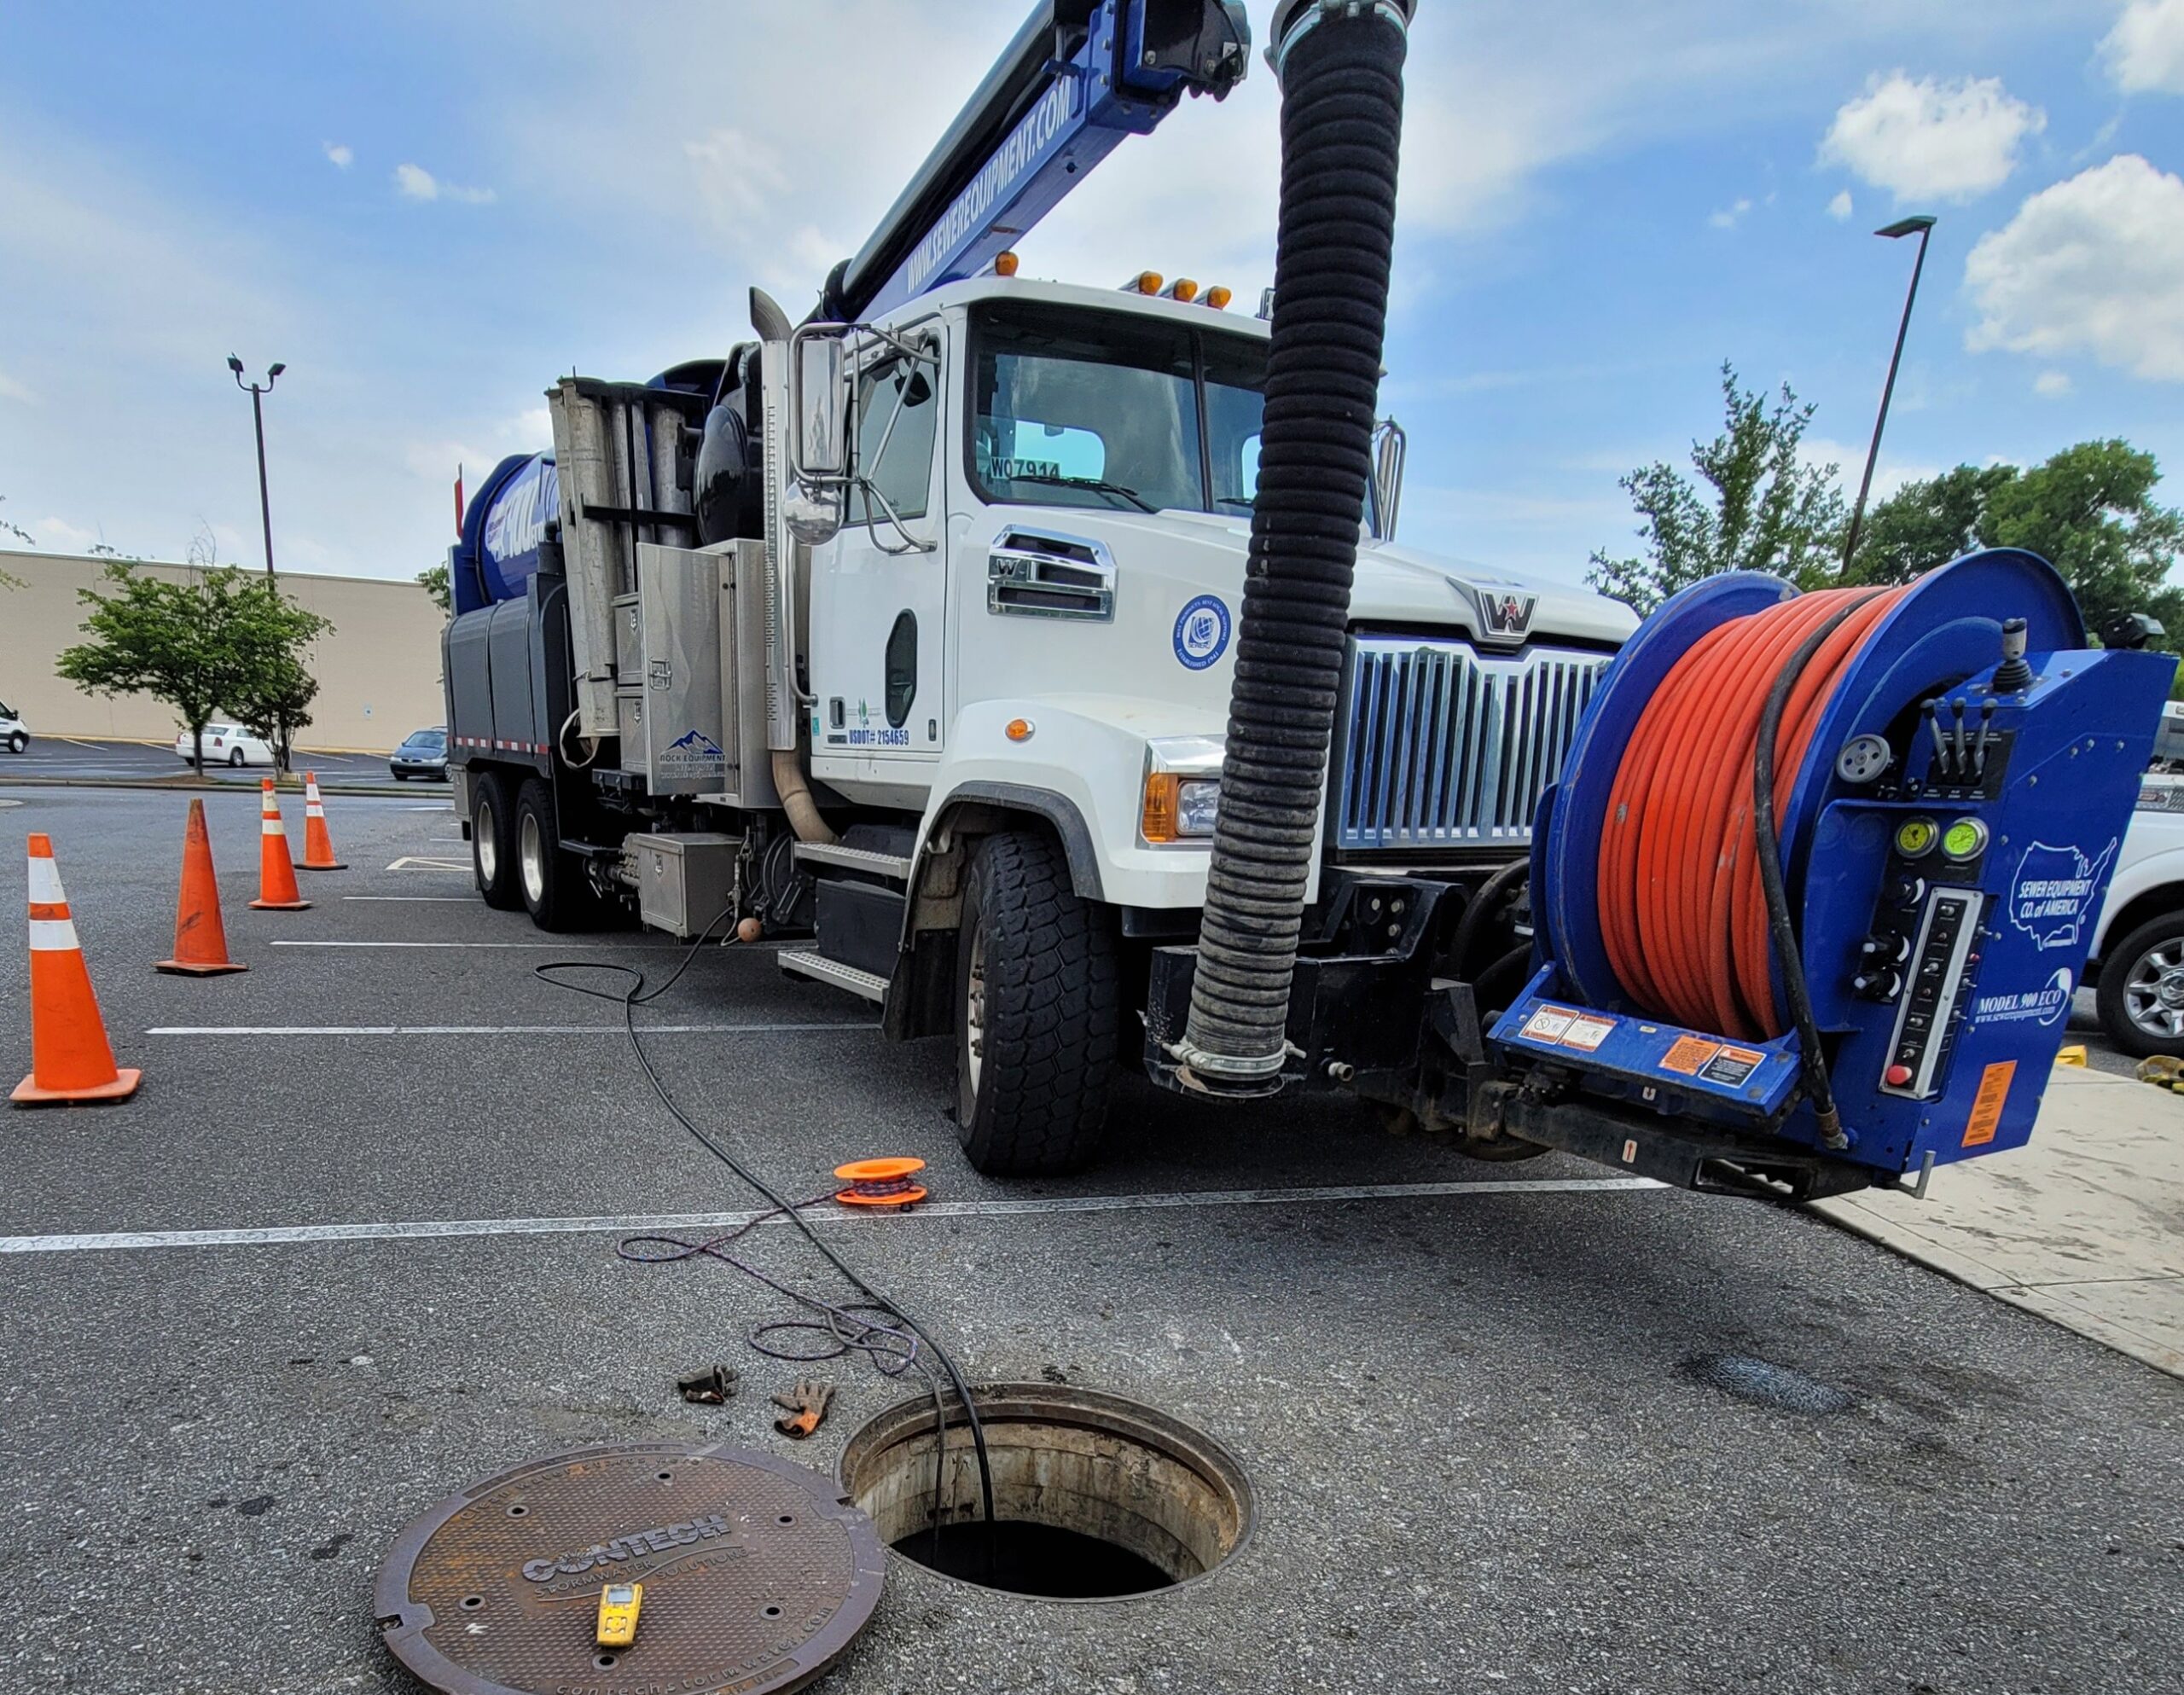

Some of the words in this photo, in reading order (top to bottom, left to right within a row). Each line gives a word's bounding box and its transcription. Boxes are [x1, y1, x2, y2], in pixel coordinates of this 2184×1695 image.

[907, 74, 1072, 294] WWW.SEWEREQUIPMENT.COM
[2018, 880, 2048, 898] SEWER
[2046, 879, 2093, 898] EQUIPMENT
[2043, 899, 2079, 916] AMERICA
[1977, 995, 2018, 1014] MODEL
[2019, 992, 2038, 1008] 900
[2037, 990, 2061, 1006] ECO
[460, 1490, 510, 1520] Clean
[522, 1514, 731, 1582] CONTECH
[534, 1559, 656, 1597] STORMWATER
[655, 1548, 749, 1580] SOLUTIONS
